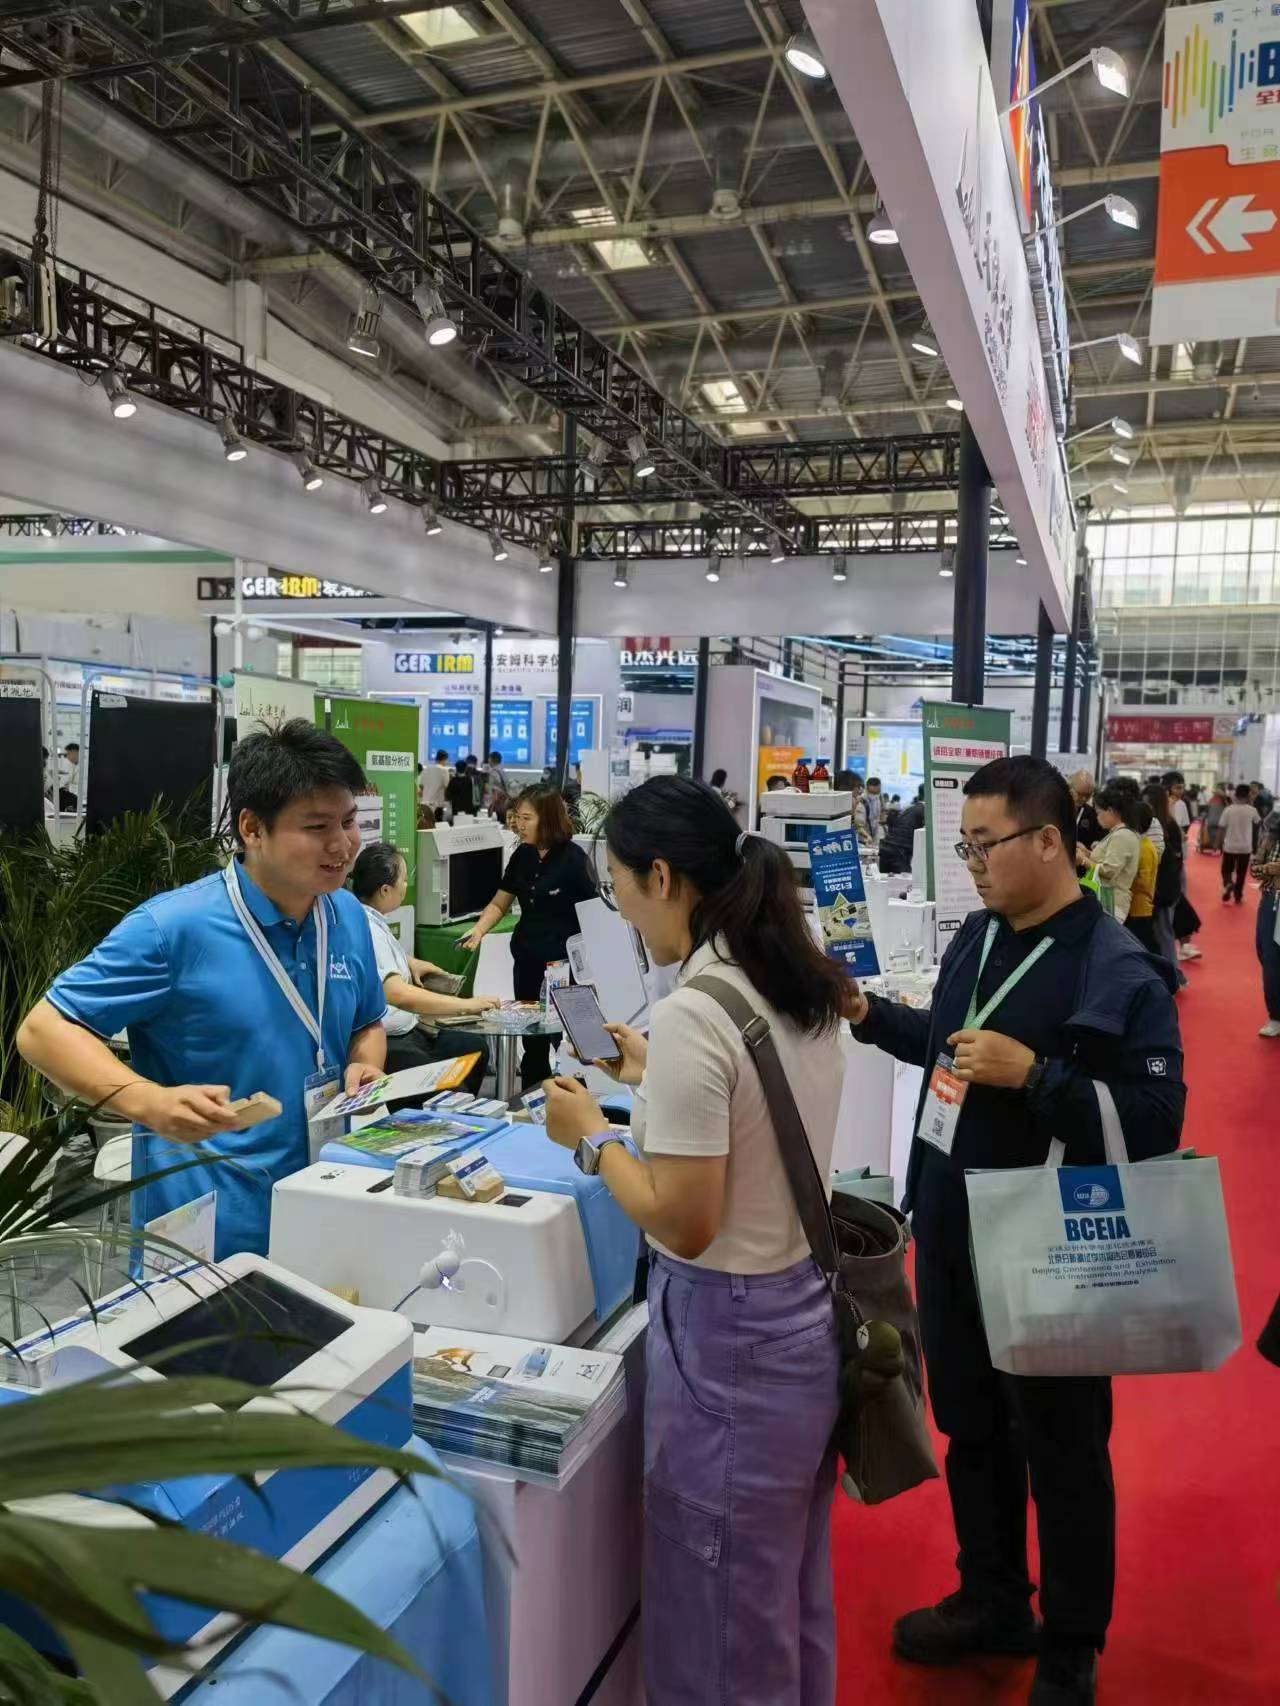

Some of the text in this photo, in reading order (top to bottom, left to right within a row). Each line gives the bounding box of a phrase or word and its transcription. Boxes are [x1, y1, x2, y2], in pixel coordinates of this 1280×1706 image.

[242, 577, 279, 597] GER
[396, 654, 473, 673] GER IRM
[825, 882, 852, 893] E1261
[1064, 1215, 1131, 1242] BCEIA
[1031, 1266, 1060, 1276] Beijing
[1135, 1257, 1176, 1270] Exhibition
